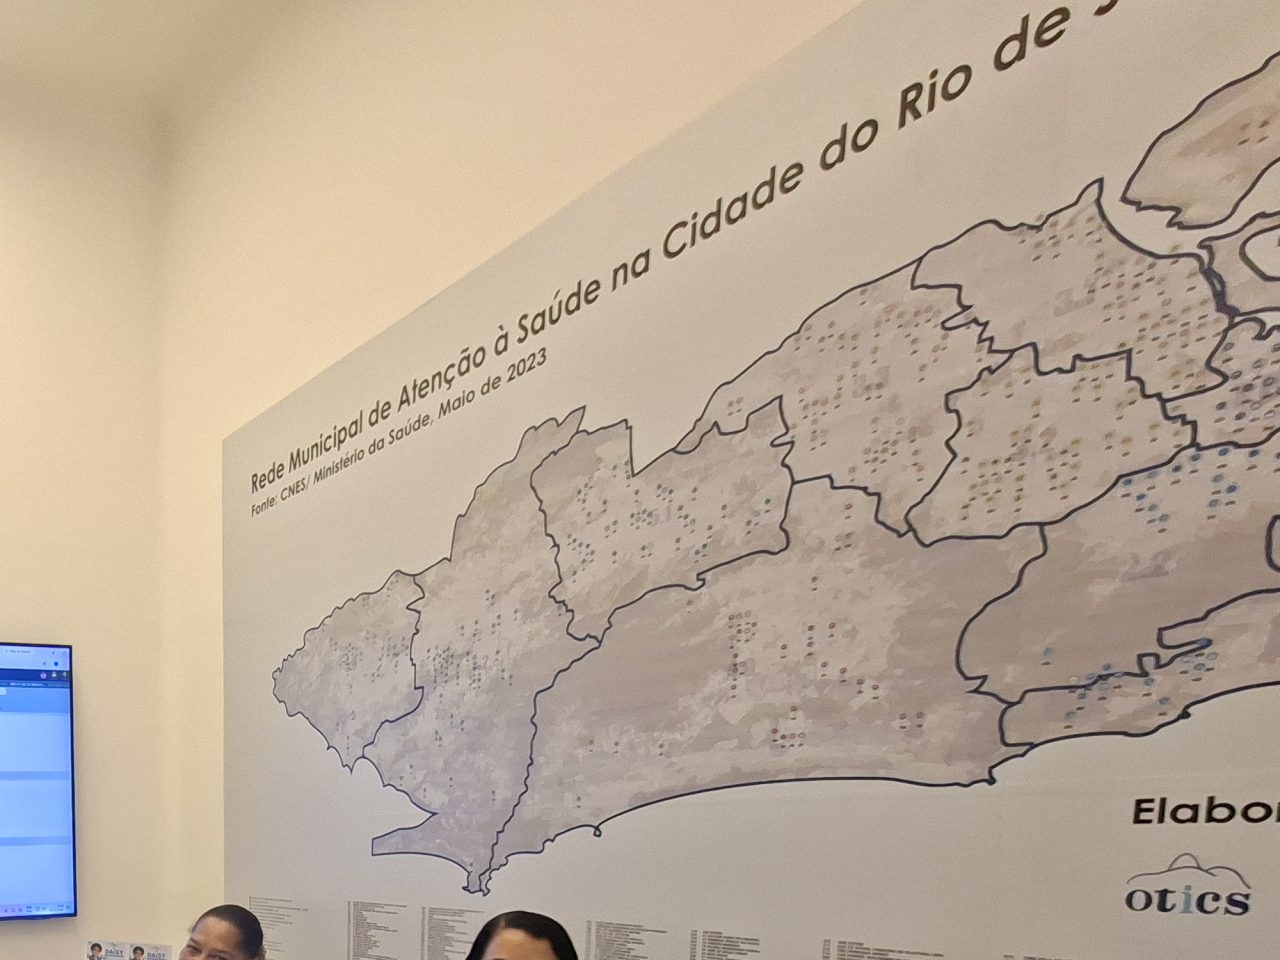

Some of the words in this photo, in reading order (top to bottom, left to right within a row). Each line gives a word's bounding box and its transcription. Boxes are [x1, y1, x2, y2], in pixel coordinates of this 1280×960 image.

[251, 461, 285, 495] Rede
[288, 409, 365, 474] Municipal
[368, 399, 392, 428] de
[397, 346, 487, 413] Atenção
[494, 324, 509, 357] à
[516, 279, 601, 344] Saúde
[611, 248, 651, 292] na
[662, 162, 804, 260] Cidade
[819, 118, 879, 171] do
[897, 64, 973, 131] Rio
[993, 6, 1071, 72] de
[251, 494, 279, 518] Fonte:
[280, 474, 311, 502] CNES/
[313, 448, 365, 485] Ministério
[368, 438, 385, 455] da
[388, 412, 434, 445] Saúde,
[438, 389, 476, 420] Maio
[481, 376, 502, 396] de
[507, 347, 547, 384] 2023
[1125, 885, 1251, 916] otics
